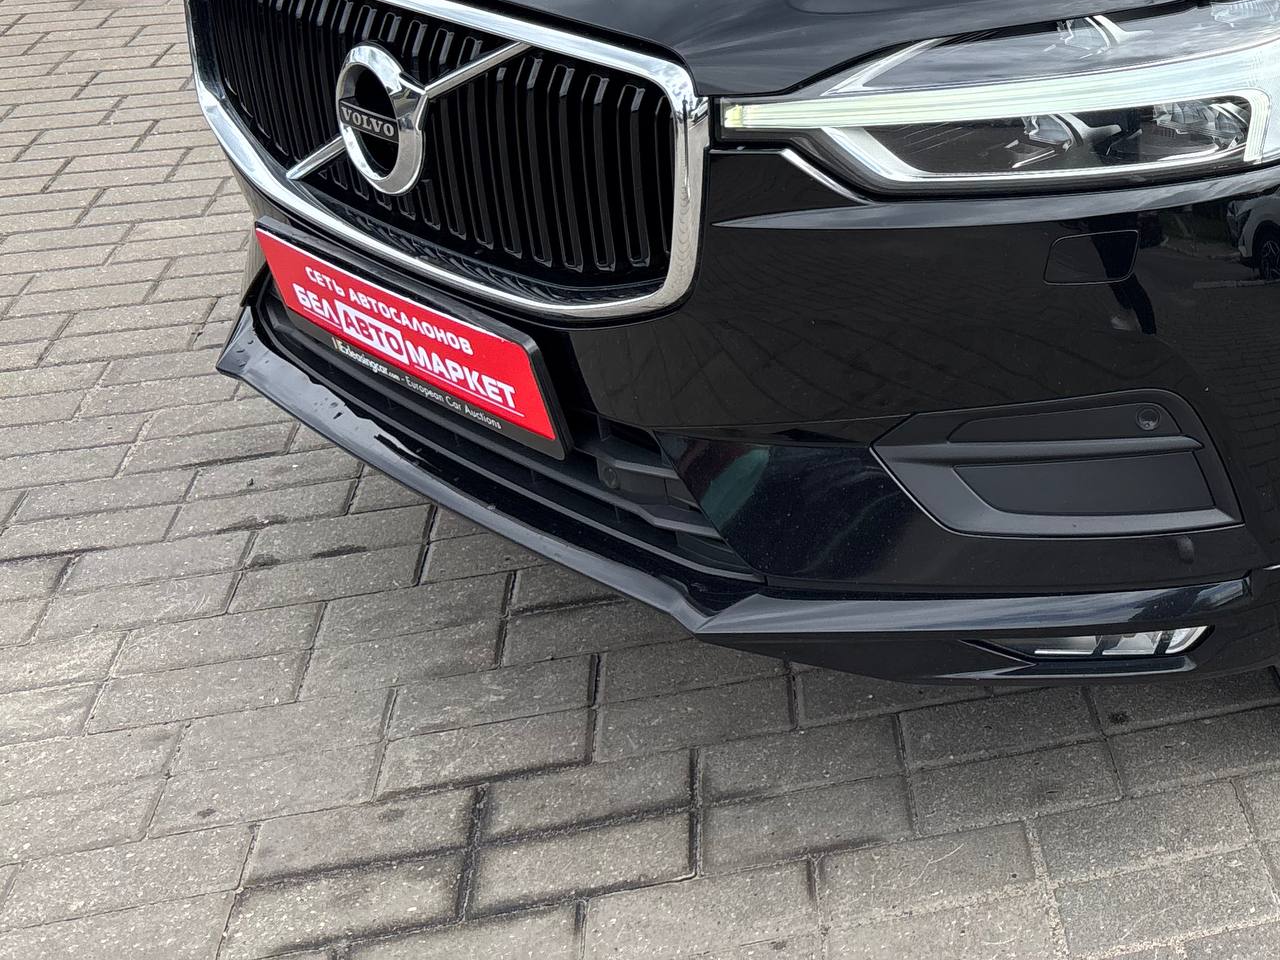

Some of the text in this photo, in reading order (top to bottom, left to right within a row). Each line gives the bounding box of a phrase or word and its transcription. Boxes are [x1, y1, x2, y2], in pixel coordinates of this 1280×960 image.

[341, 106, 395, 137] VOLVO
[304, 265, 474, 356] СЕТЬ АВТОСАЛОНОВ
[405, 375, 445, 403] European
[445, 395, 462, 412] Car
[464, 402, 502, 430] Auctions
